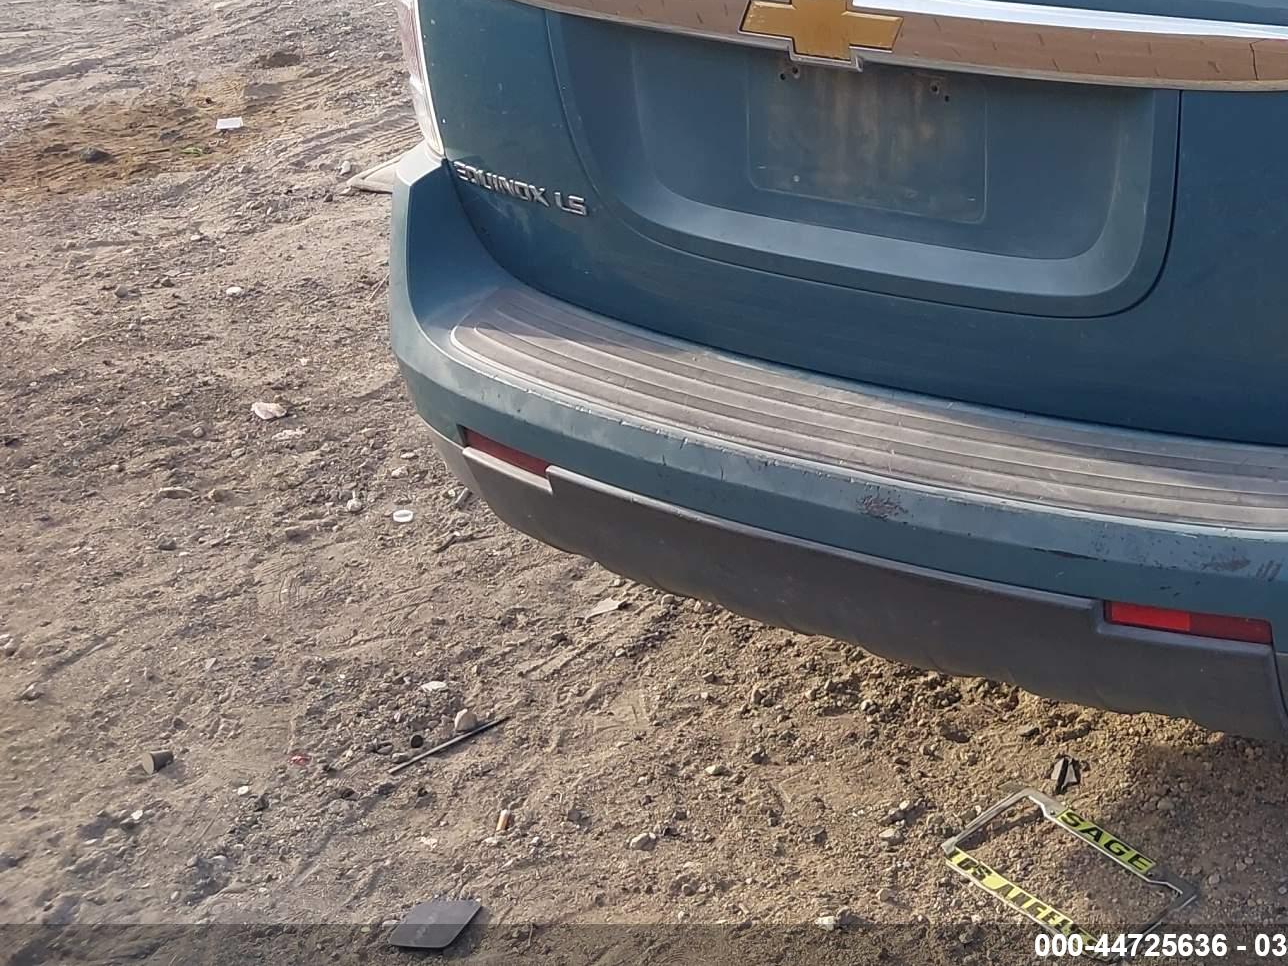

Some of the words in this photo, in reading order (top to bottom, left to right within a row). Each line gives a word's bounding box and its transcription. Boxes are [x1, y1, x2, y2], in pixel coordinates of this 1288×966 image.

[453, 160, 551, 208] EQUINOX
[554, 191, 588, 216] LS
[1059, 809, 1153, 872] SAGE
